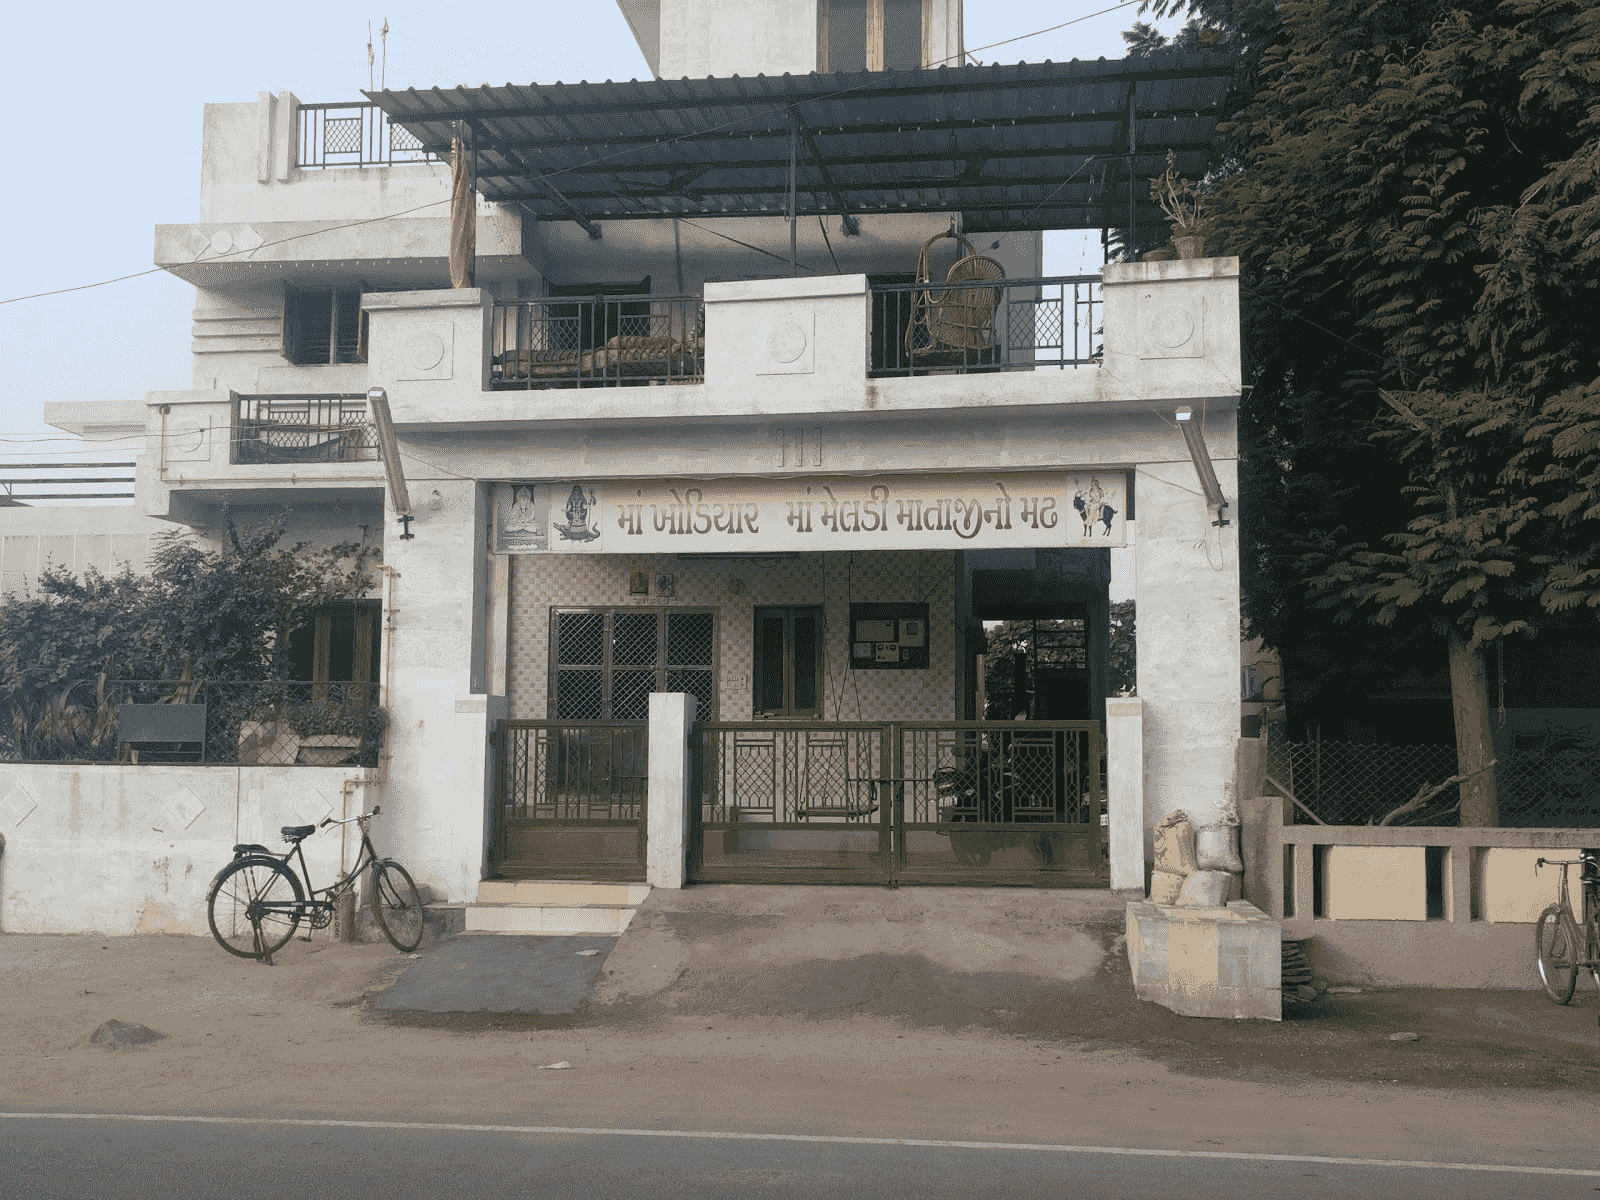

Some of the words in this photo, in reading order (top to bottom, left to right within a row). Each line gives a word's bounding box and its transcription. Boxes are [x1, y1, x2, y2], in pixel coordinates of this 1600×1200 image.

[617, 488, 643, 535] માં
[651, 488, 759, 535] ખોડિયાર
[786, 485, 812, 532] માં
[820, 484, 889, 532] મેલડી
[897, 482, 1012, 539] માતાજીનો
